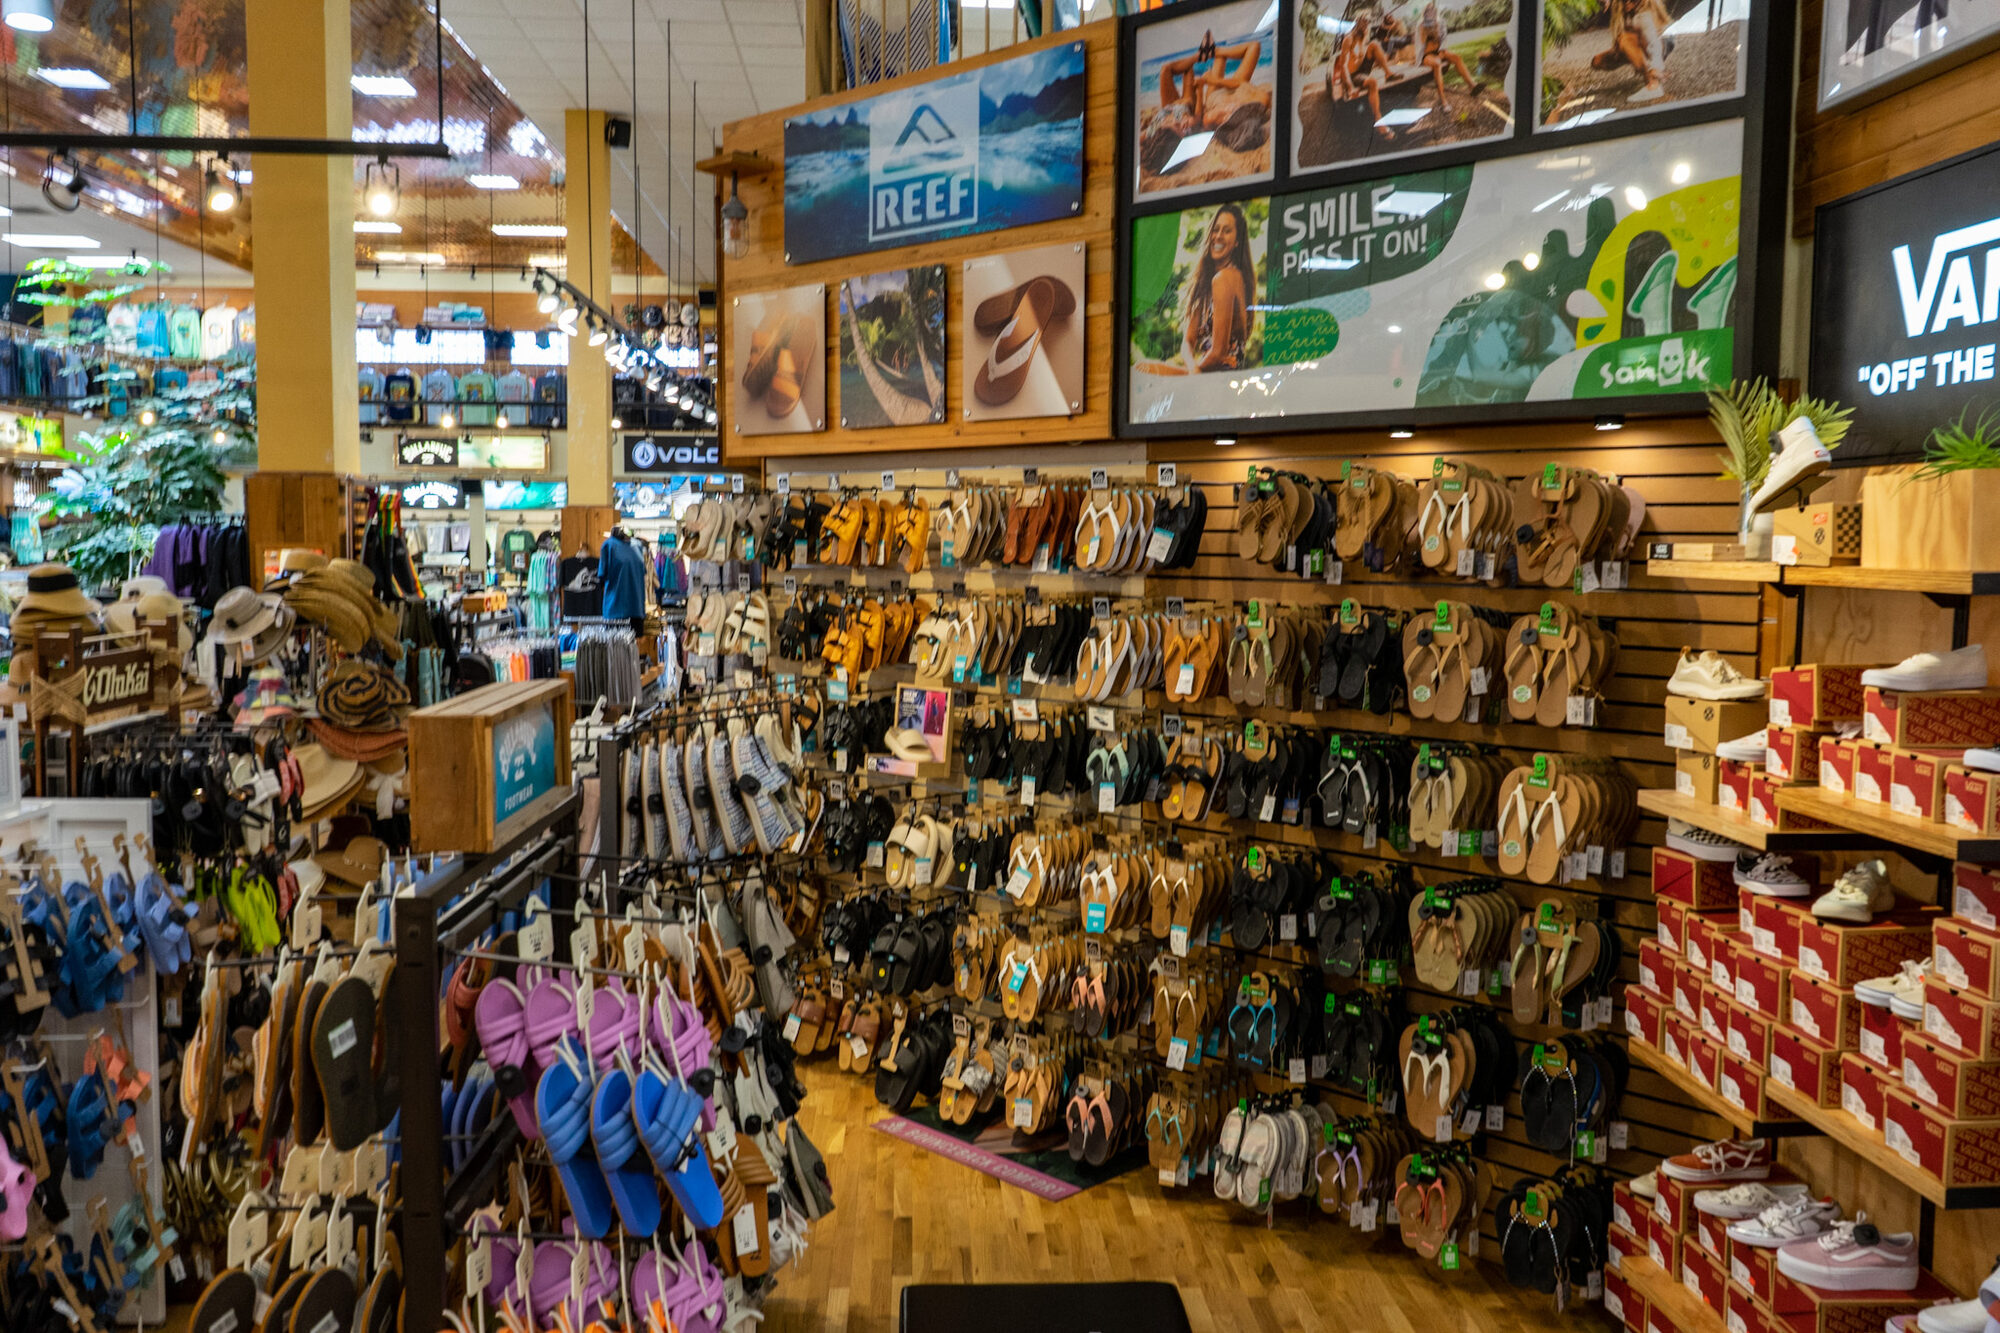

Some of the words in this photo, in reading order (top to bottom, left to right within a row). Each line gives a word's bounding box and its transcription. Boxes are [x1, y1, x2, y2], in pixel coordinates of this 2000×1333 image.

[876, 171, 971, 231] REEF
[1283, 240, 1342, 278] PASS
[1352, 233, 1377, 264] IT
[1383, 223, 1428, 259] ON!
[1932, 343, 1997, 388] THE
[94, 661, 151, 704] OluKai
